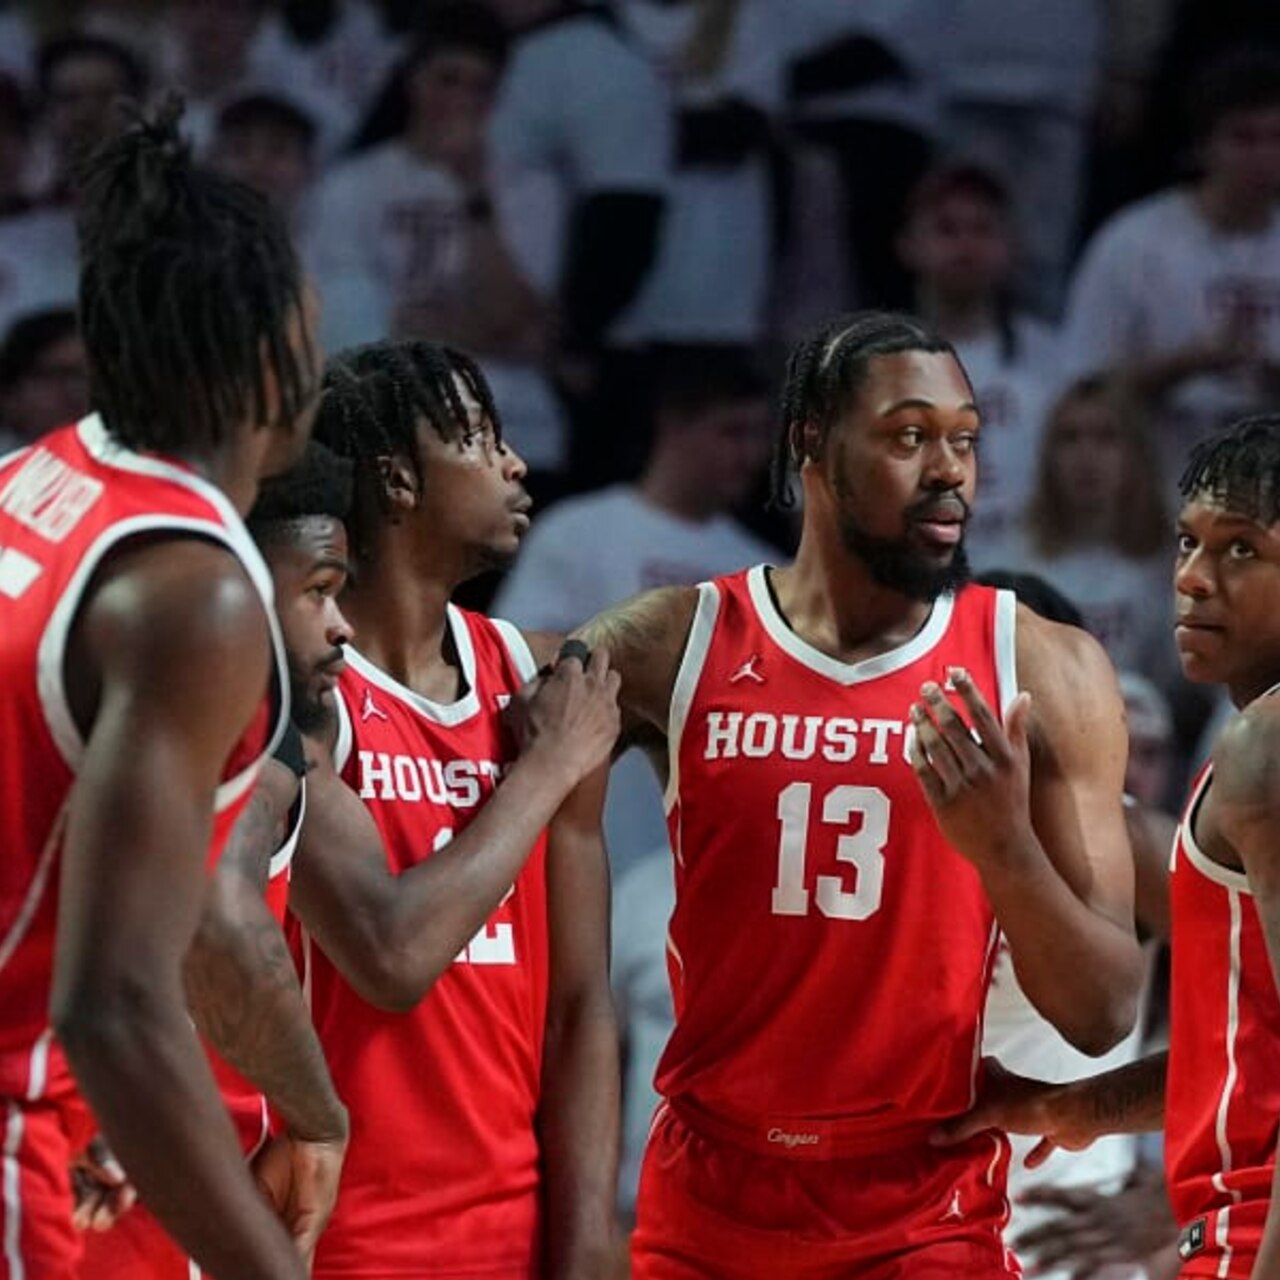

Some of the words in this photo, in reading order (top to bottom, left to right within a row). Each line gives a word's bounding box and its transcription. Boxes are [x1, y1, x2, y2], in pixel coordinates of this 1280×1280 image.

[704, 711, 917, 765] HOUST
[357, 750, 501, 807] HOUST
[772, 782, 891, 921] 13
